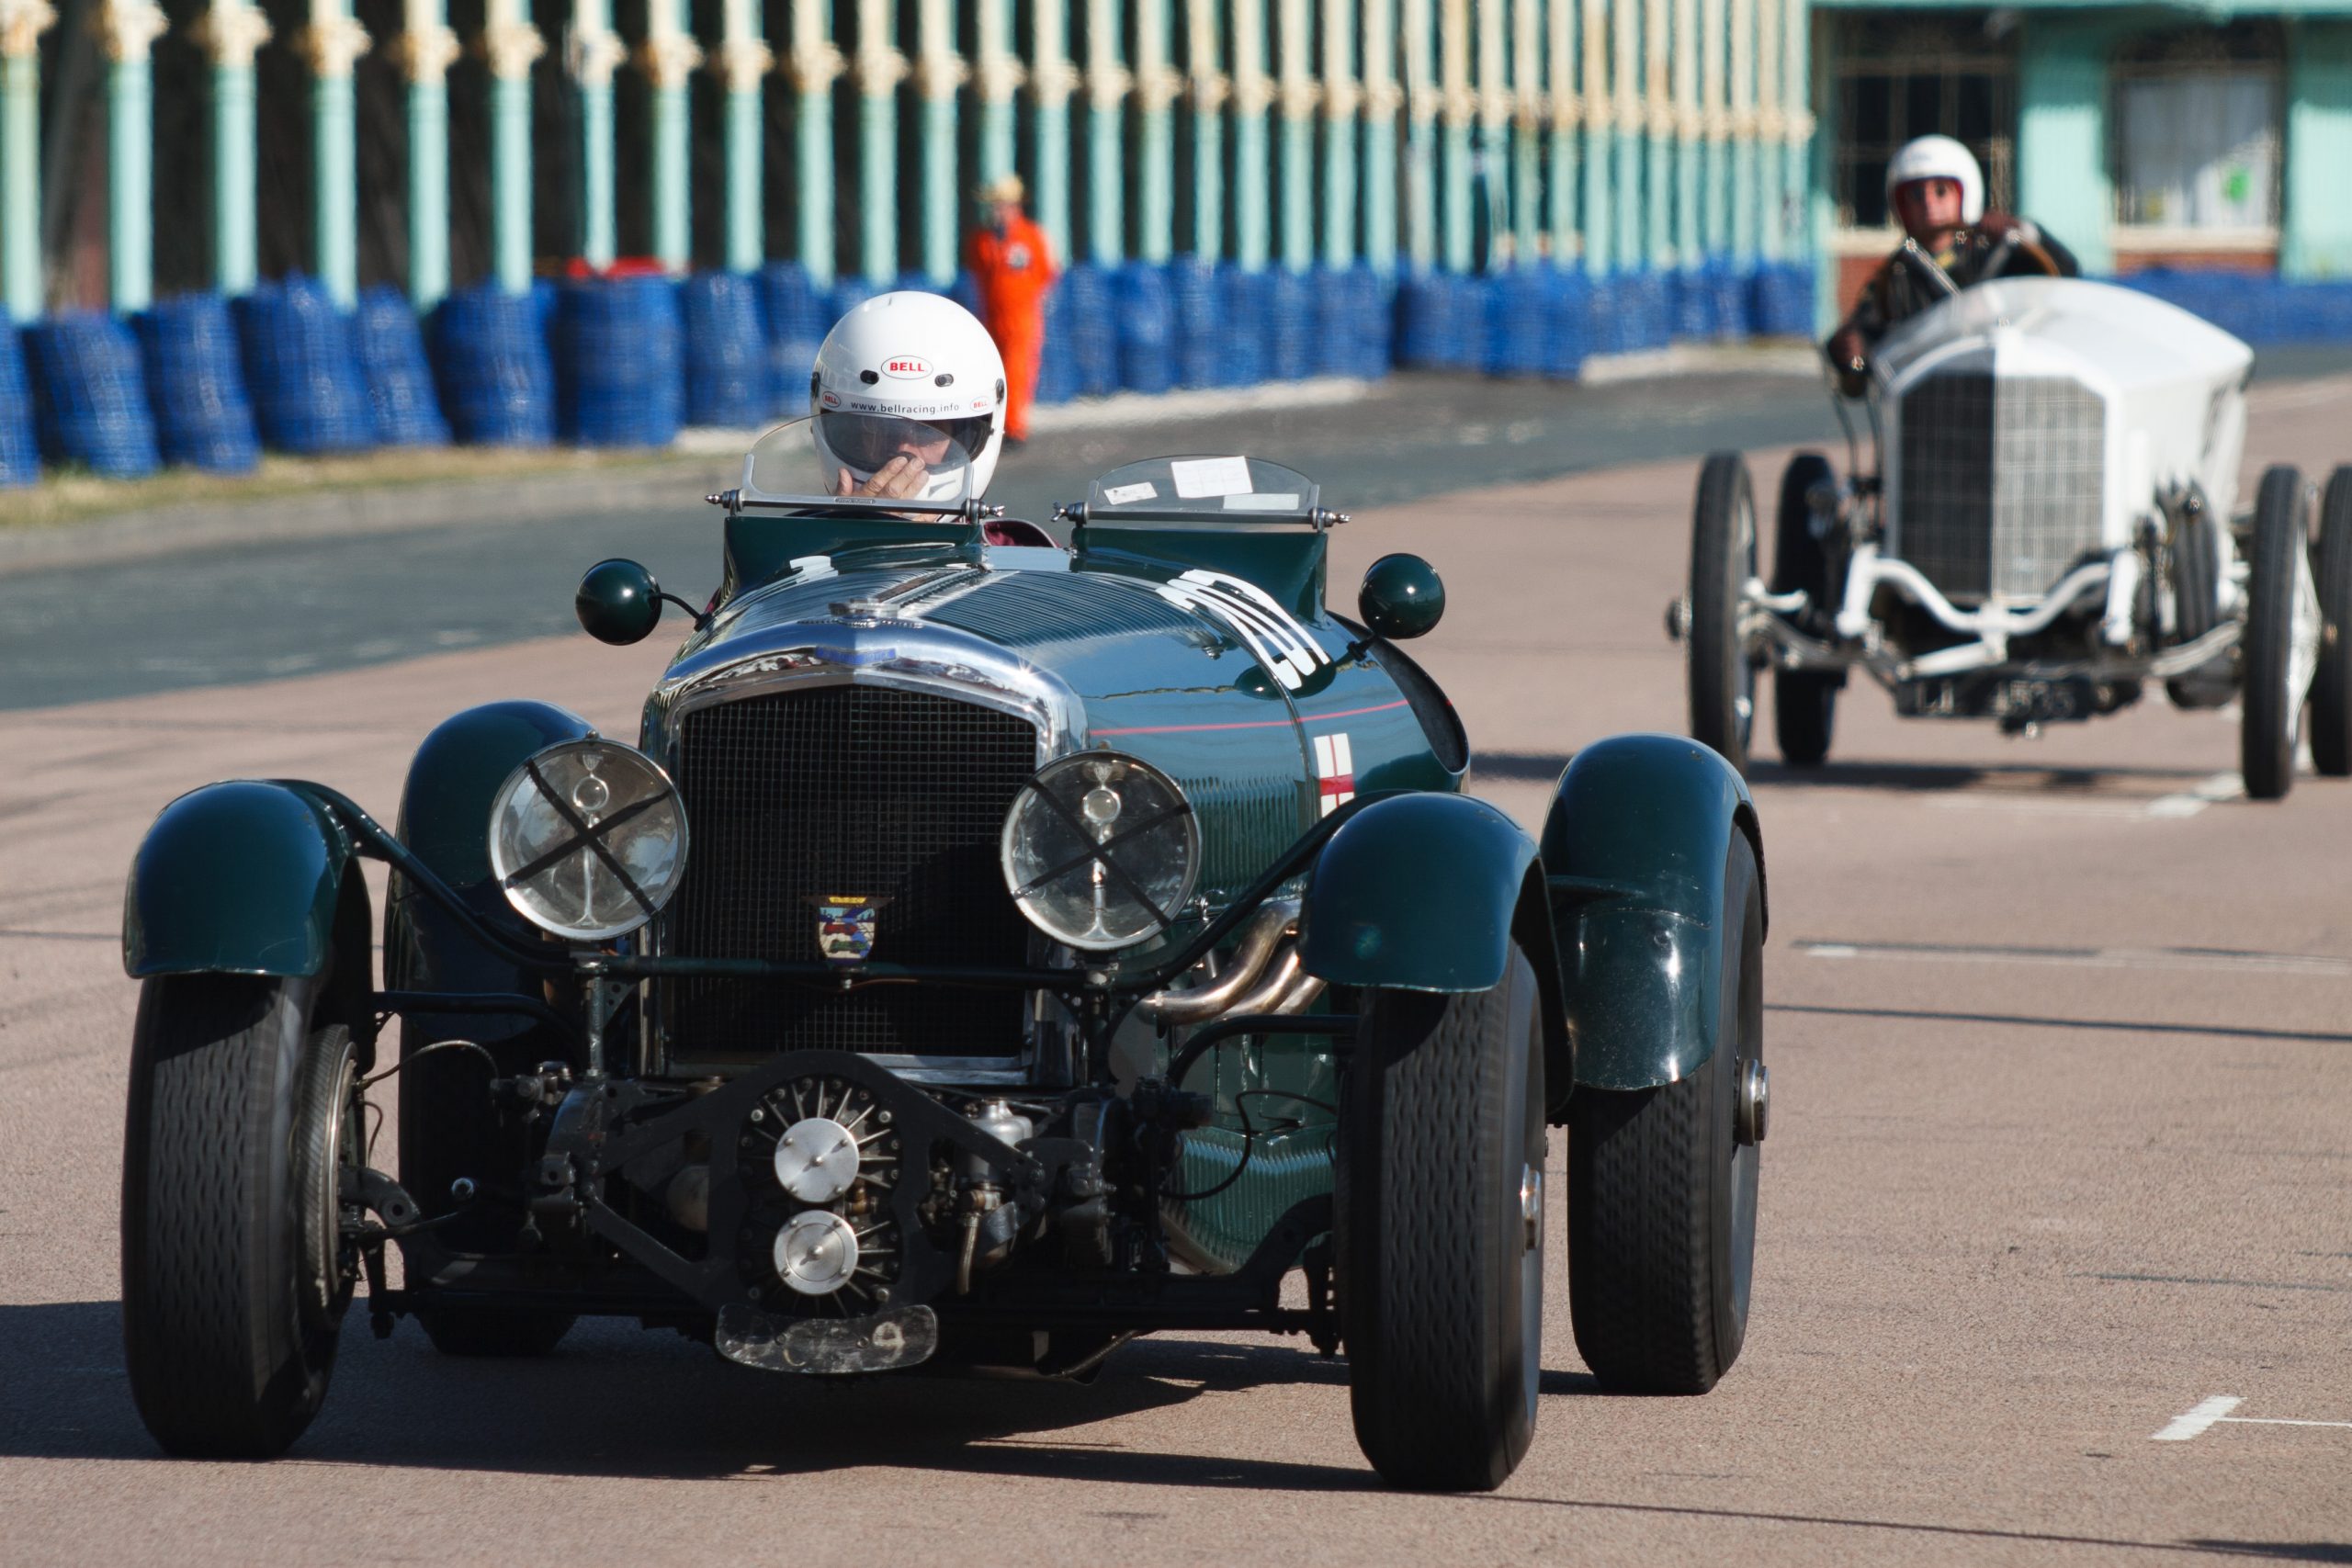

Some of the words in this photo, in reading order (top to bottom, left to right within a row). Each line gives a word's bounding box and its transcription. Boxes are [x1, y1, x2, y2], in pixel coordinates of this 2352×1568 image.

[888, 362, 925, 372] BELL
[823, 394, 839, 406] BELL
[973, 400, 988, 409] BELL
[850, 401, 959, 415] www.bellracing.info
